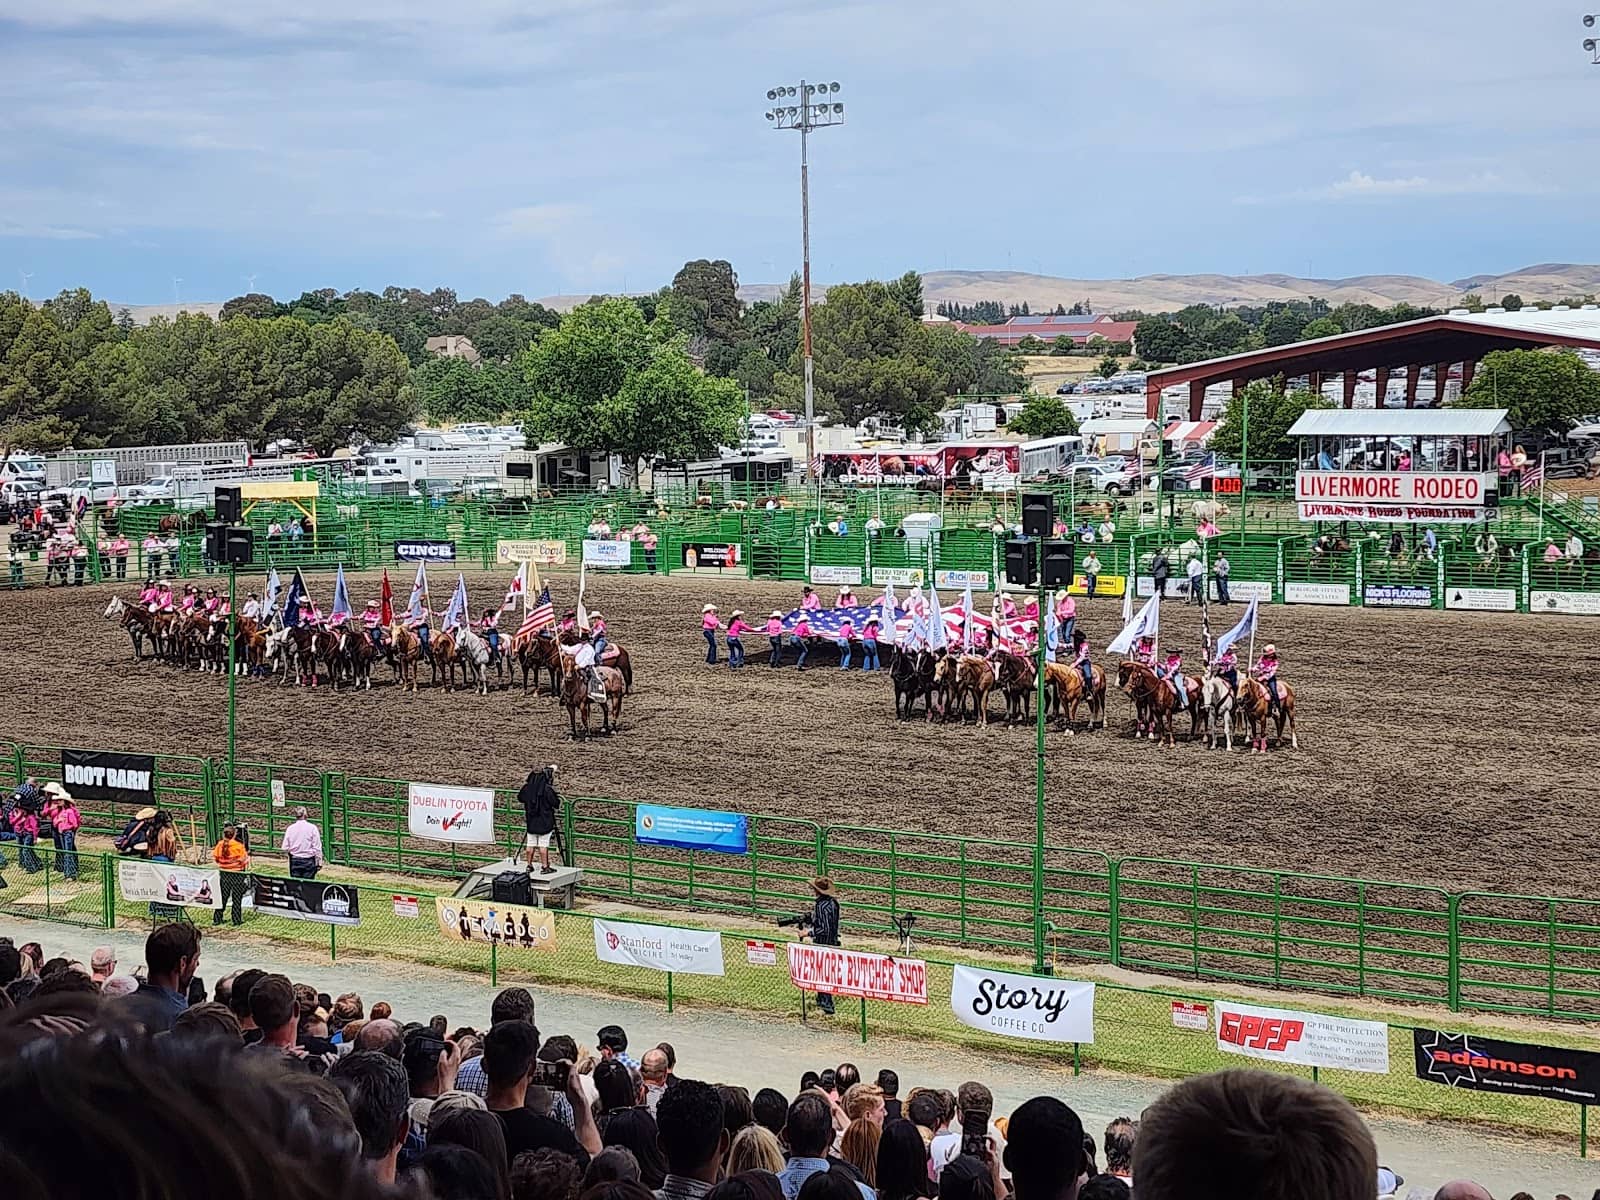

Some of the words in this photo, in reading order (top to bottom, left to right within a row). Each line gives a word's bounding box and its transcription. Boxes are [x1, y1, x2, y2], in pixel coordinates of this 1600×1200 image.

[1301, 476, 1402, 498] LIVERMORE
[1414, 478, 1478, 499] RODEO
[1304, 504, 1364, 518] LIVERMORE
[1368, 506, 1402, 518] RODEO
[1407, 507, 1476, 519] FOUNDATION
[397, 543, 456, 557] CINCH
[1392, 589, 1432, 599] FLOORING
[64, 764, 105, 787] BOOT
[107, 767, 151, 791] BARN
[413, 795, 447, 809] DUBLIN
[450, 799, 488, 811] TOYOTA
[620, 935, 662, 950] Stanford
[670, 941, 692, 952] Health
[693, 944, 710, 953] Care
[848, 955, 894, 992] BUTCHER
[900, 963, 924, 996] SHOP
[973, 978, 1069, 1023] Story
[1173, 1007, 1207, 1016] STANDING
[991, 1016, 1027, 1031] COFFEE
[1031, 1022, 1046, 1034] CO.
[1219, 1011, 1305, 1051] GPFP
[1336, 1025, 1384, 1037] PROTECTION
[1433, 1050, 1577, 1080] adamson
